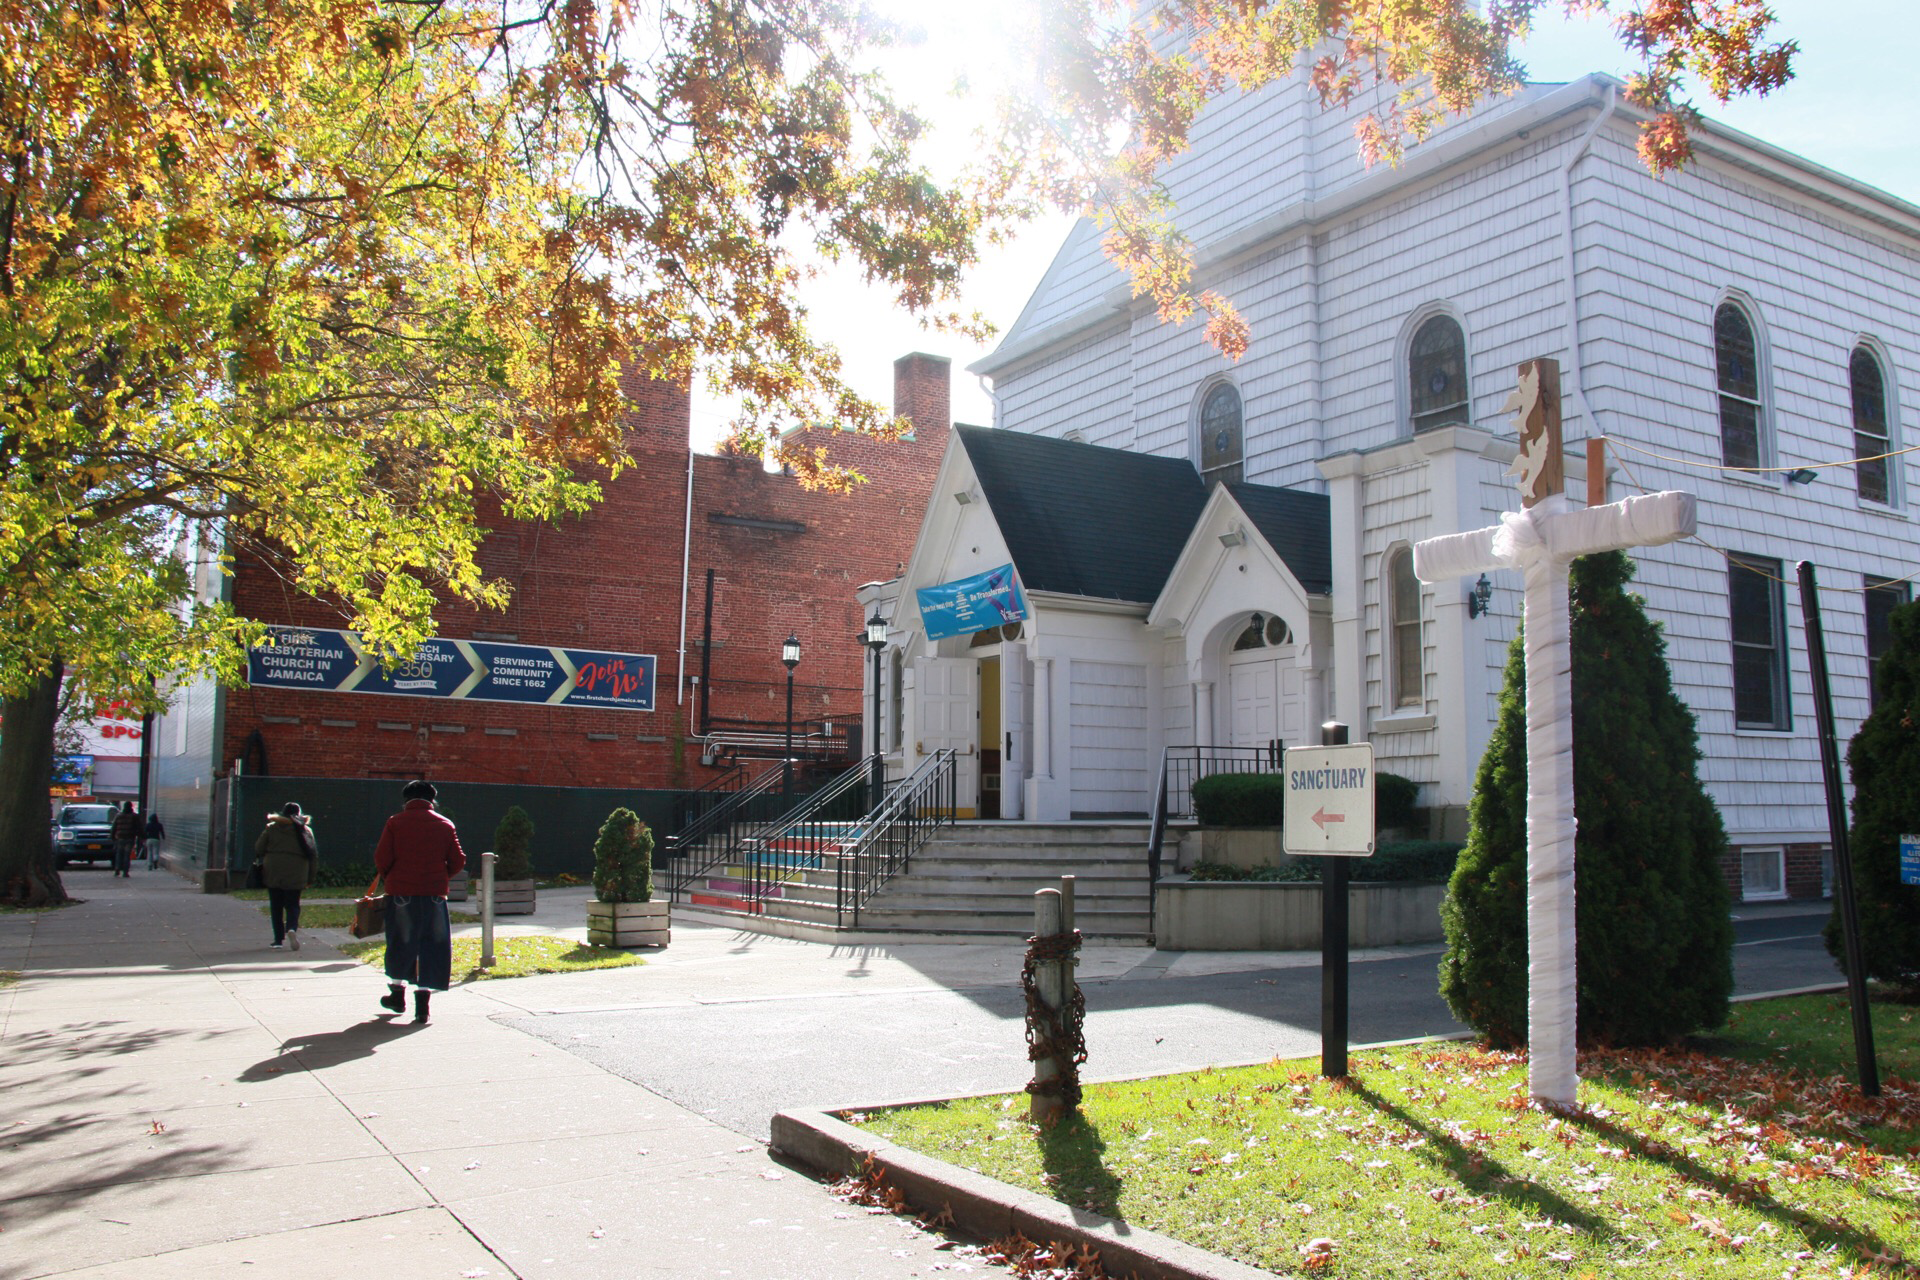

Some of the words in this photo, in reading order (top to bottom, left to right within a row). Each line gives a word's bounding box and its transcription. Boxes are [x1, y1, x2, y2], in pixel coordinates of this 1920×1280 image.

[281, 633, 316, 645] FIRST
[250, 645, 344, 660] PRESBYTERIAN
[262, 656, 314, 669] CHURCH
[317, 660, 331, 670] IN
[399, 660, 433, 678] 350
[493, 656, 535, 668] SERVING
[536, 660, 554, 669] THE
[266, 669, 325, 682] JAMAICA
[492, 667, 553, 678] COMMUNITY
[575, 658, 626, 691] Join
[492, 677, 521, 686] SINCE
[524, 680, 546, 688] 1662
[605, 666, 645, 697] Us!
[570, 694, 647, 704] www.firstchurchjamaica.org
[1290, 767, 1366, 791] SANCTUARY
